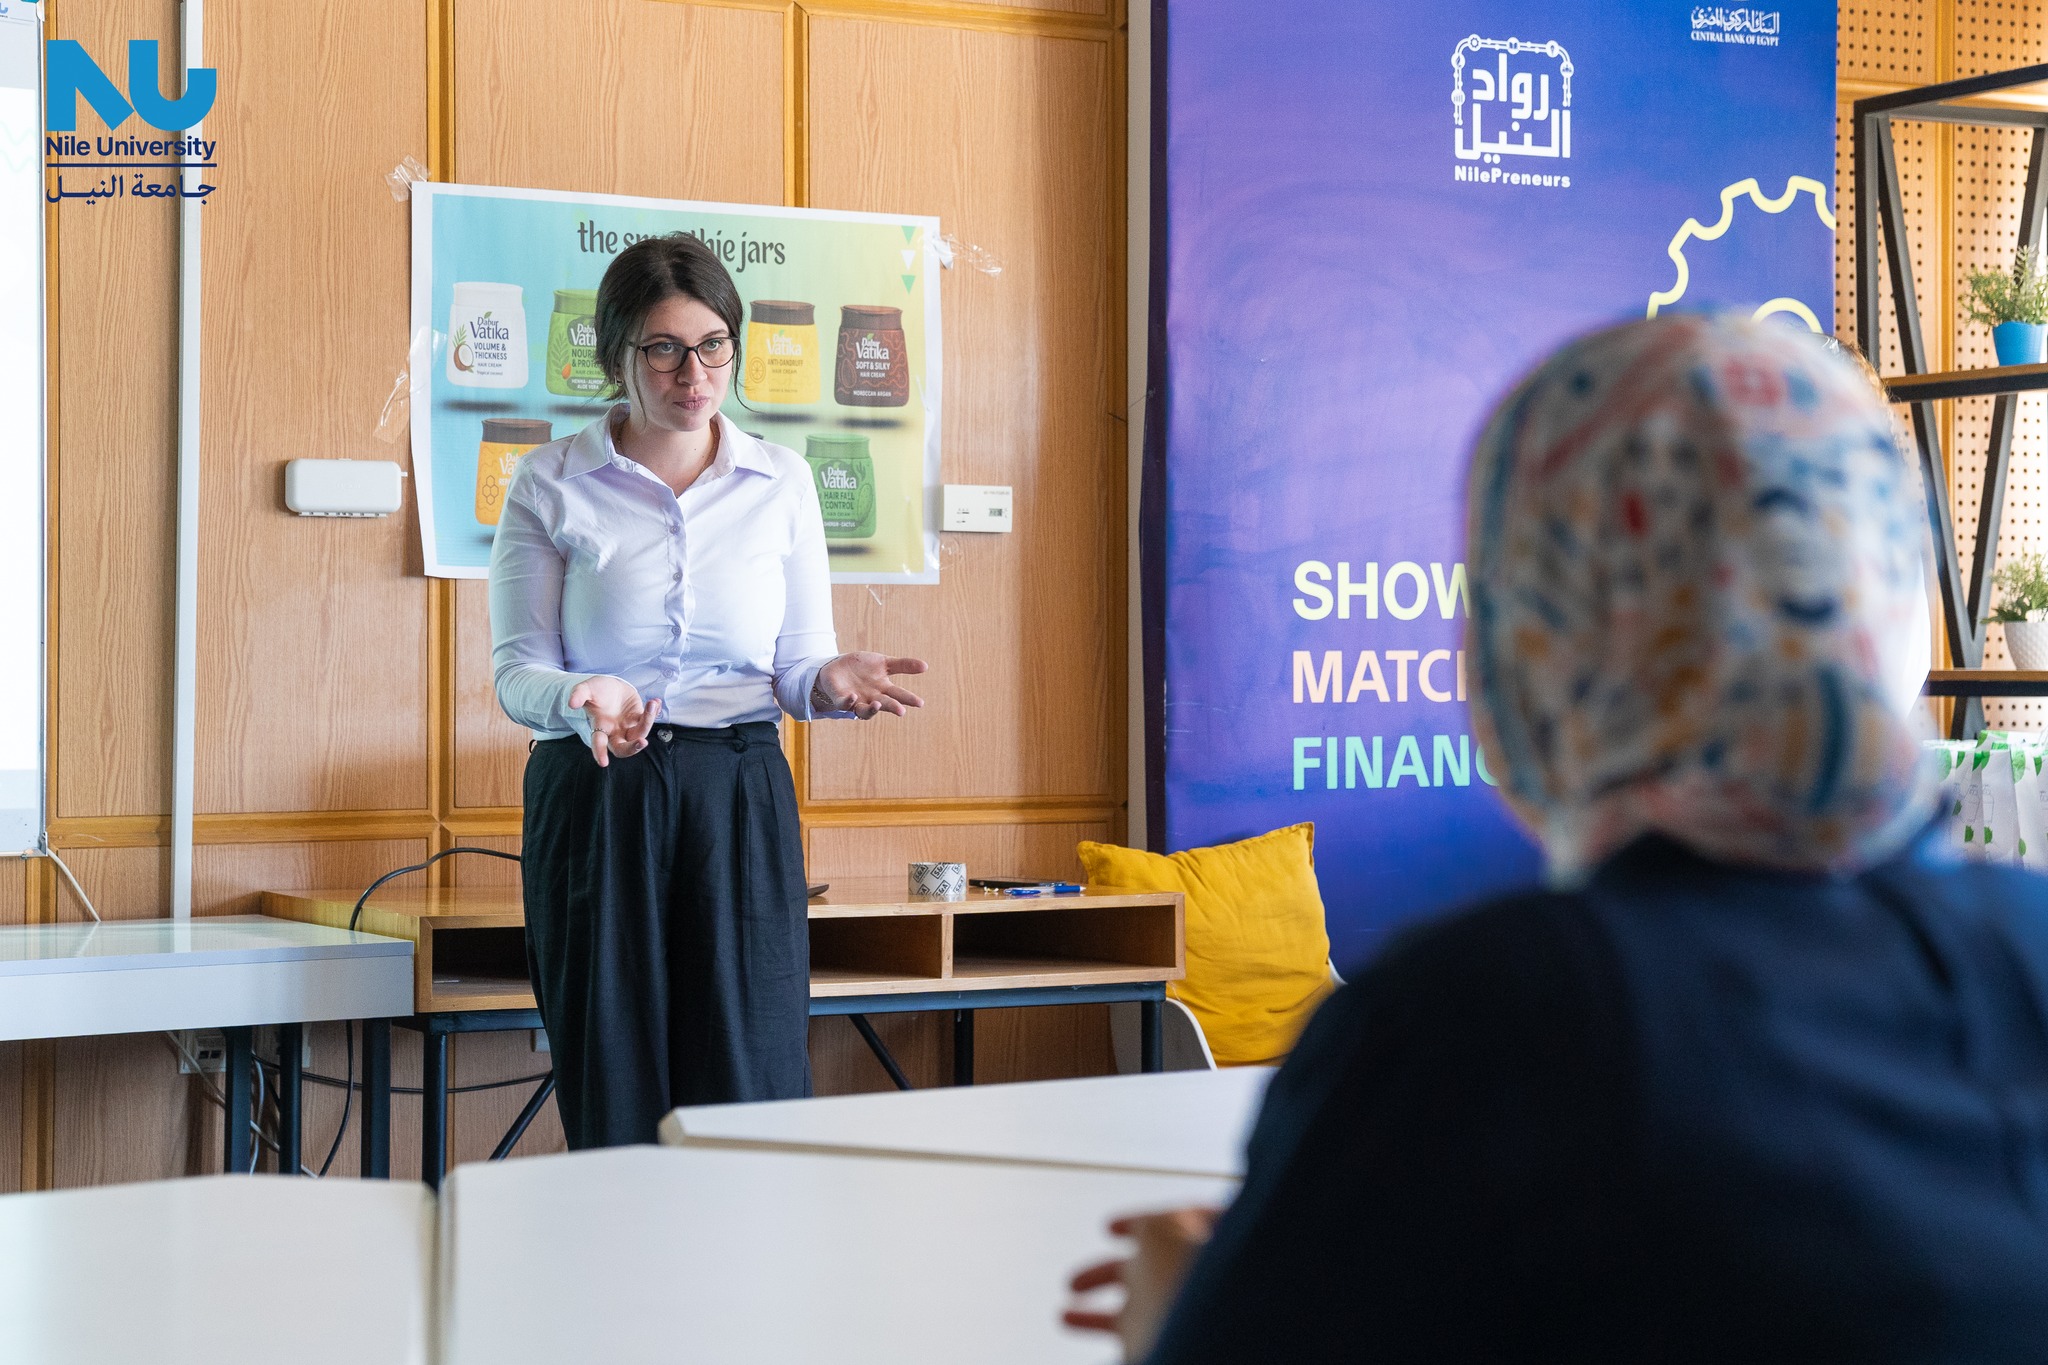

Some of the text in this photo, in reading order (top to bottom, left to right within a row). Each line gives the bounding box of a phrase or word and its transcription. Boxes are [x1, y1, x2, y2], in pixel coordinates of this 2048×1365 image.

[1691, 30, 1779, 47] CENTRAL BANK OF EGYPT
[1472, 52, 1549, 121] رواد
[1455, 103, 1571, 164] النيل
[1454, 165, 1571, 188] NilePreneurs
[577, 220, 618, 255] the
[736, 231, 786, 273] jars
[477, 316, 499, 326] Dabur
[470, 320, 509, 340] Vatika
[474, 342, 500, 351] VOLUME
[572, 349, 595, 358] NOURI
[766, 338, 802, 356] Vatika
[855, 342, 889, 360] Vatika
[475, 351, 507, 361] THICKNESS
[572, 360, 577, 368] &
[856, 361, 870, 370] SOFT
[874, 362, 890, 371] SILKY
[821, 471, 857, 489] Vatika
[824, 492, 855, 501] HAIR FALL
[824, 501, 854, 510] CONTROL
[1292, 560, 1471, 621] SHOW
